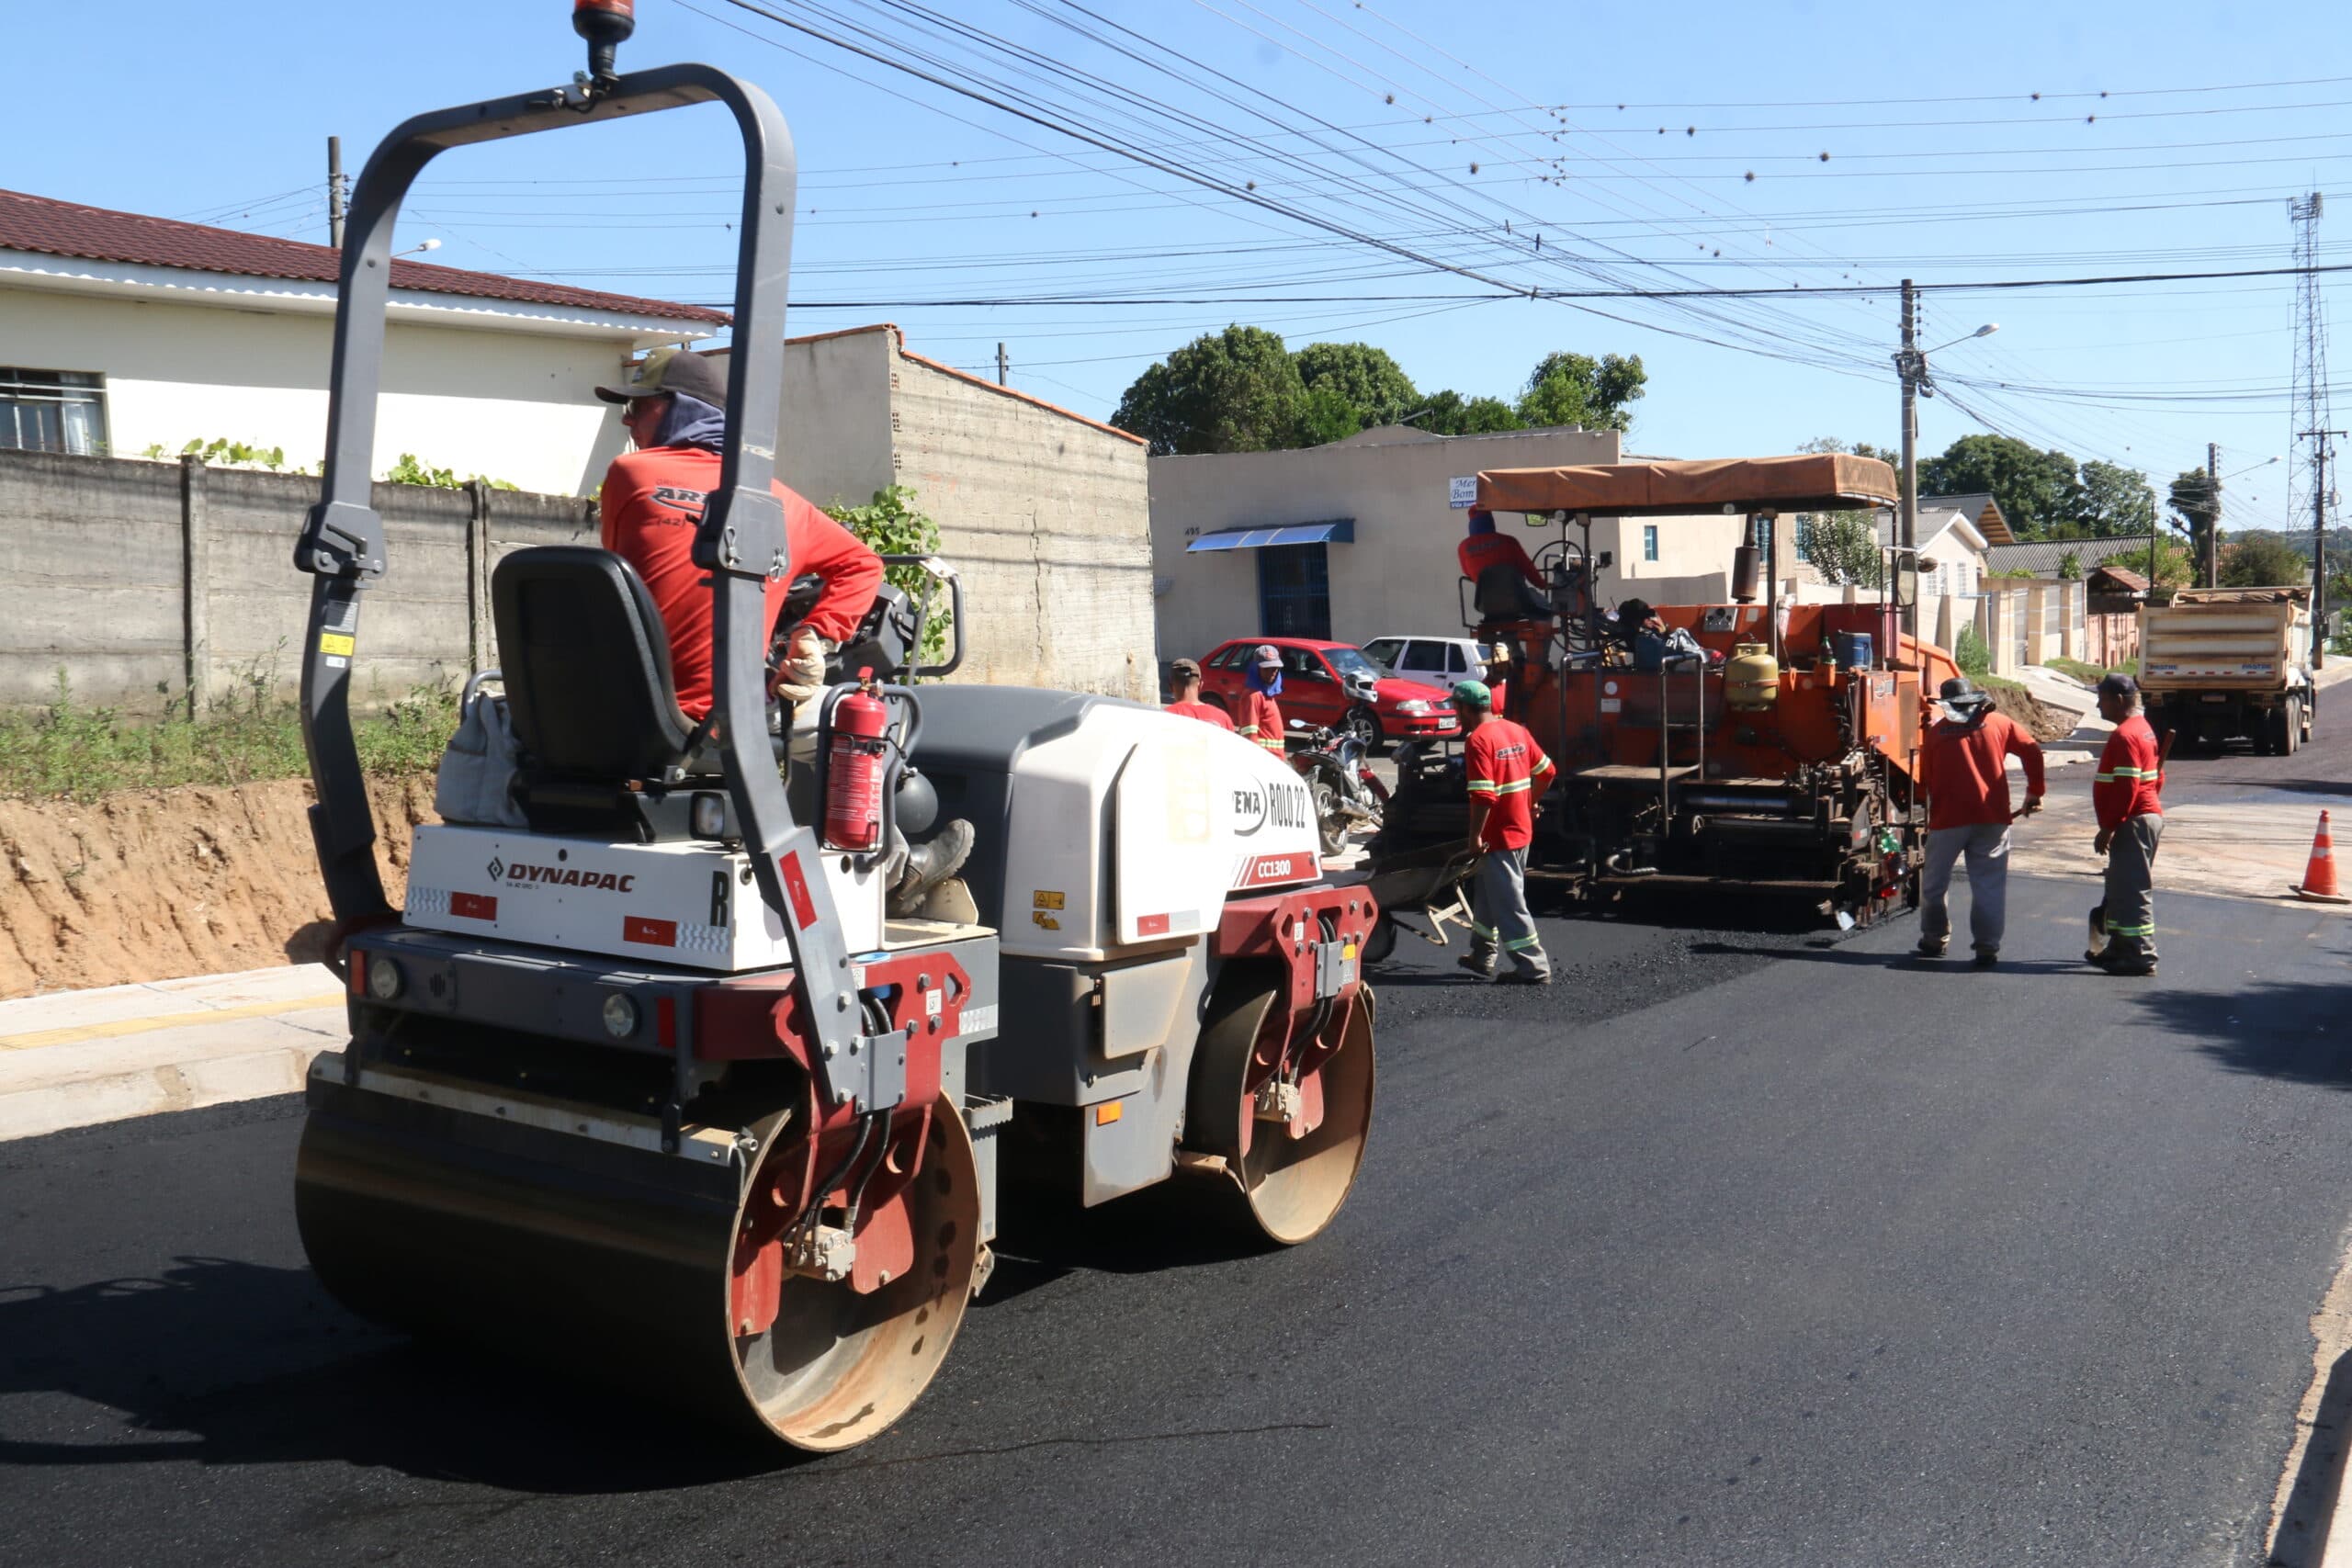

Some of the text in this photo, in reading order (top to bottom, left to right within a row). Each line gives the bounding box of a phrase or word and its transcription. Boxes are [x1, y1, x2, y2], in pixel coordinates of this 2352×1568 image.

[1453, 489, 1475, 499] Bom
[1232, 790, 1261, 815] ENA
[1269, 782, 1306, 829] ROLO 22
[507, 863, 636, 894] DYNAPAC
[1257, 860, 1292, 879] CC1300
